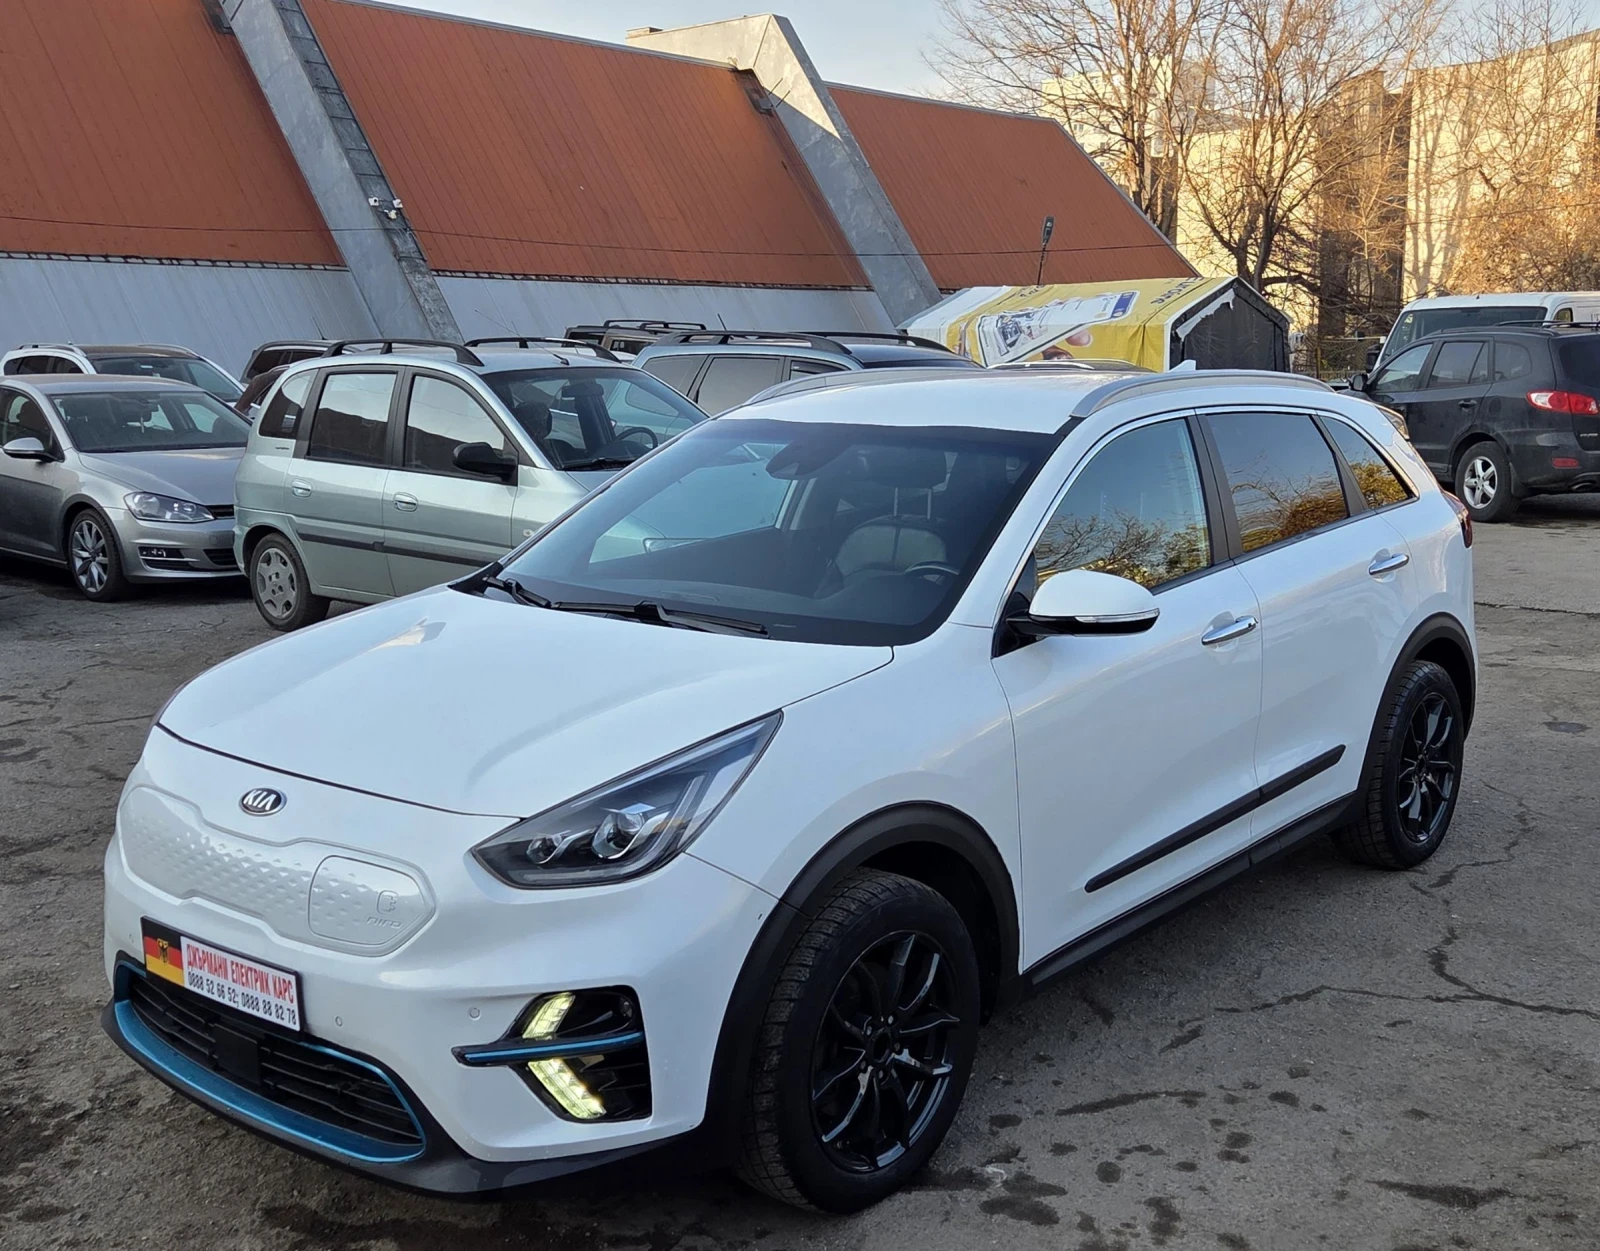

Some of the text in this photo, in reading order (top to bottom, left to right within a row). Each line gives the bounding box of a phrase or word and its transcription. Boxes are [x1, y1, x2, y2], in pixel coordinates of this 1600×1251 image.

[242, 789, 277, 811] KIA
[187, 944, 294, 1004] ДЖЪРМАНИ ЕЛЕКТРИК КАРС
[188, 971, 204, 991] 0888
[206, 978, 215, 995] 52
[216, 982, 226, 999] 66
[242, 992, 260, 1012] 0888
[262, 999, 272, 1017] 88
[275, 1003, 285, 1020] 82
[286, 1007, 297, 1025] 78
